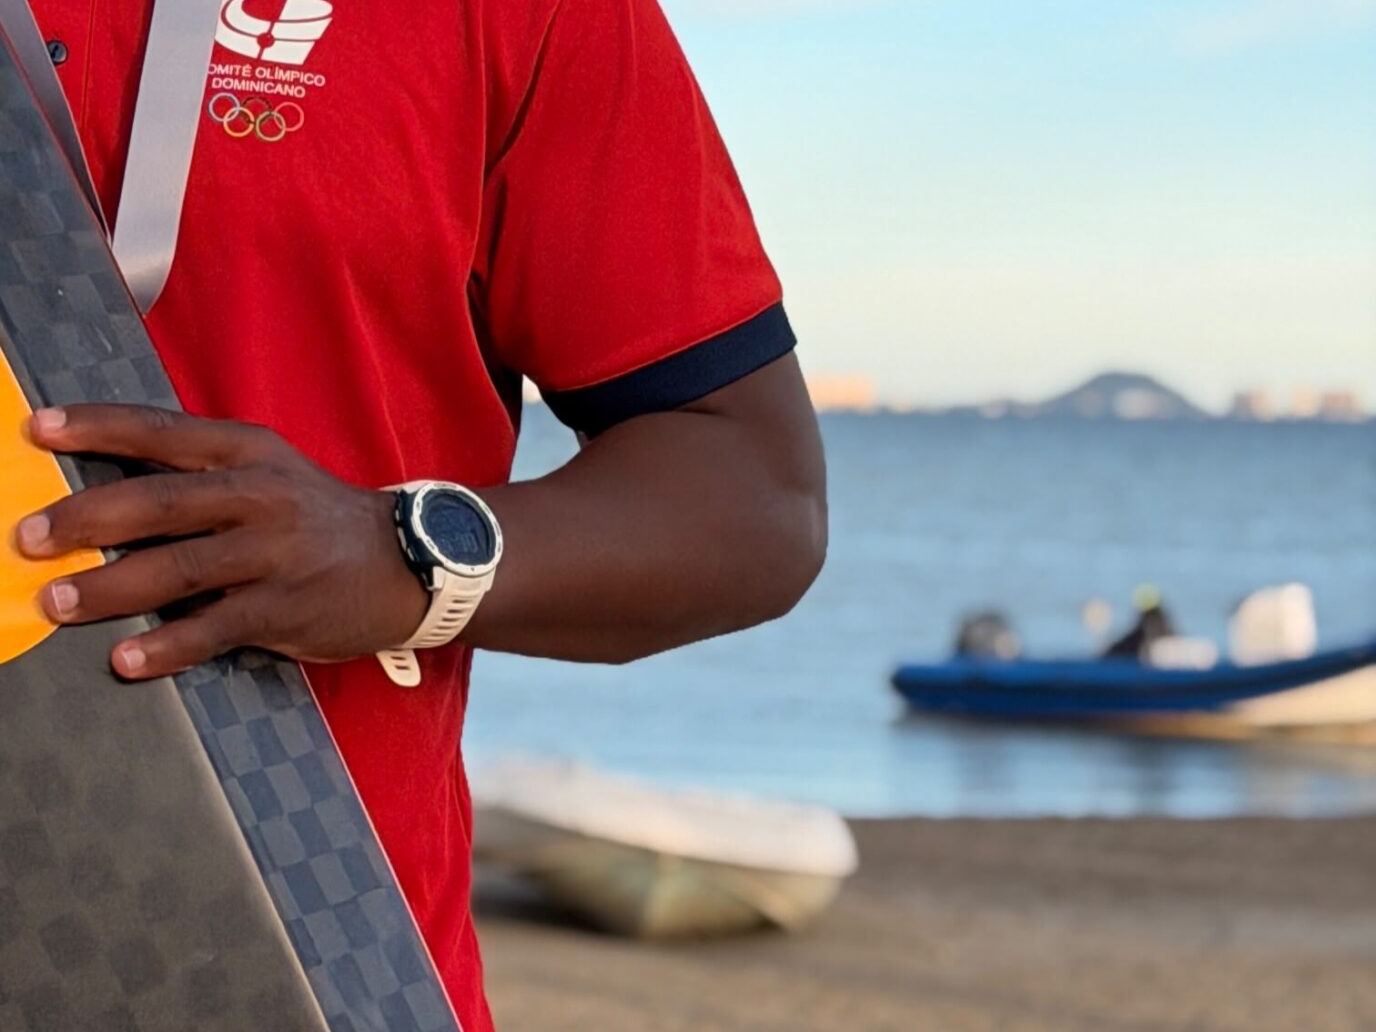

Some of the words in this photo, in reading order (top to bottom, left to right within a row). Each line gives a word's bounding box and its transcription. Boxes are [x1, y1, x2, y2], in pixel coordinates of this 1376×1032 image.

[208, 64, 252, 78] OMITÉ
[255, 65, 326, 87] OLÍMPICO
[212, 77, 306, 98] DOMINICANO
